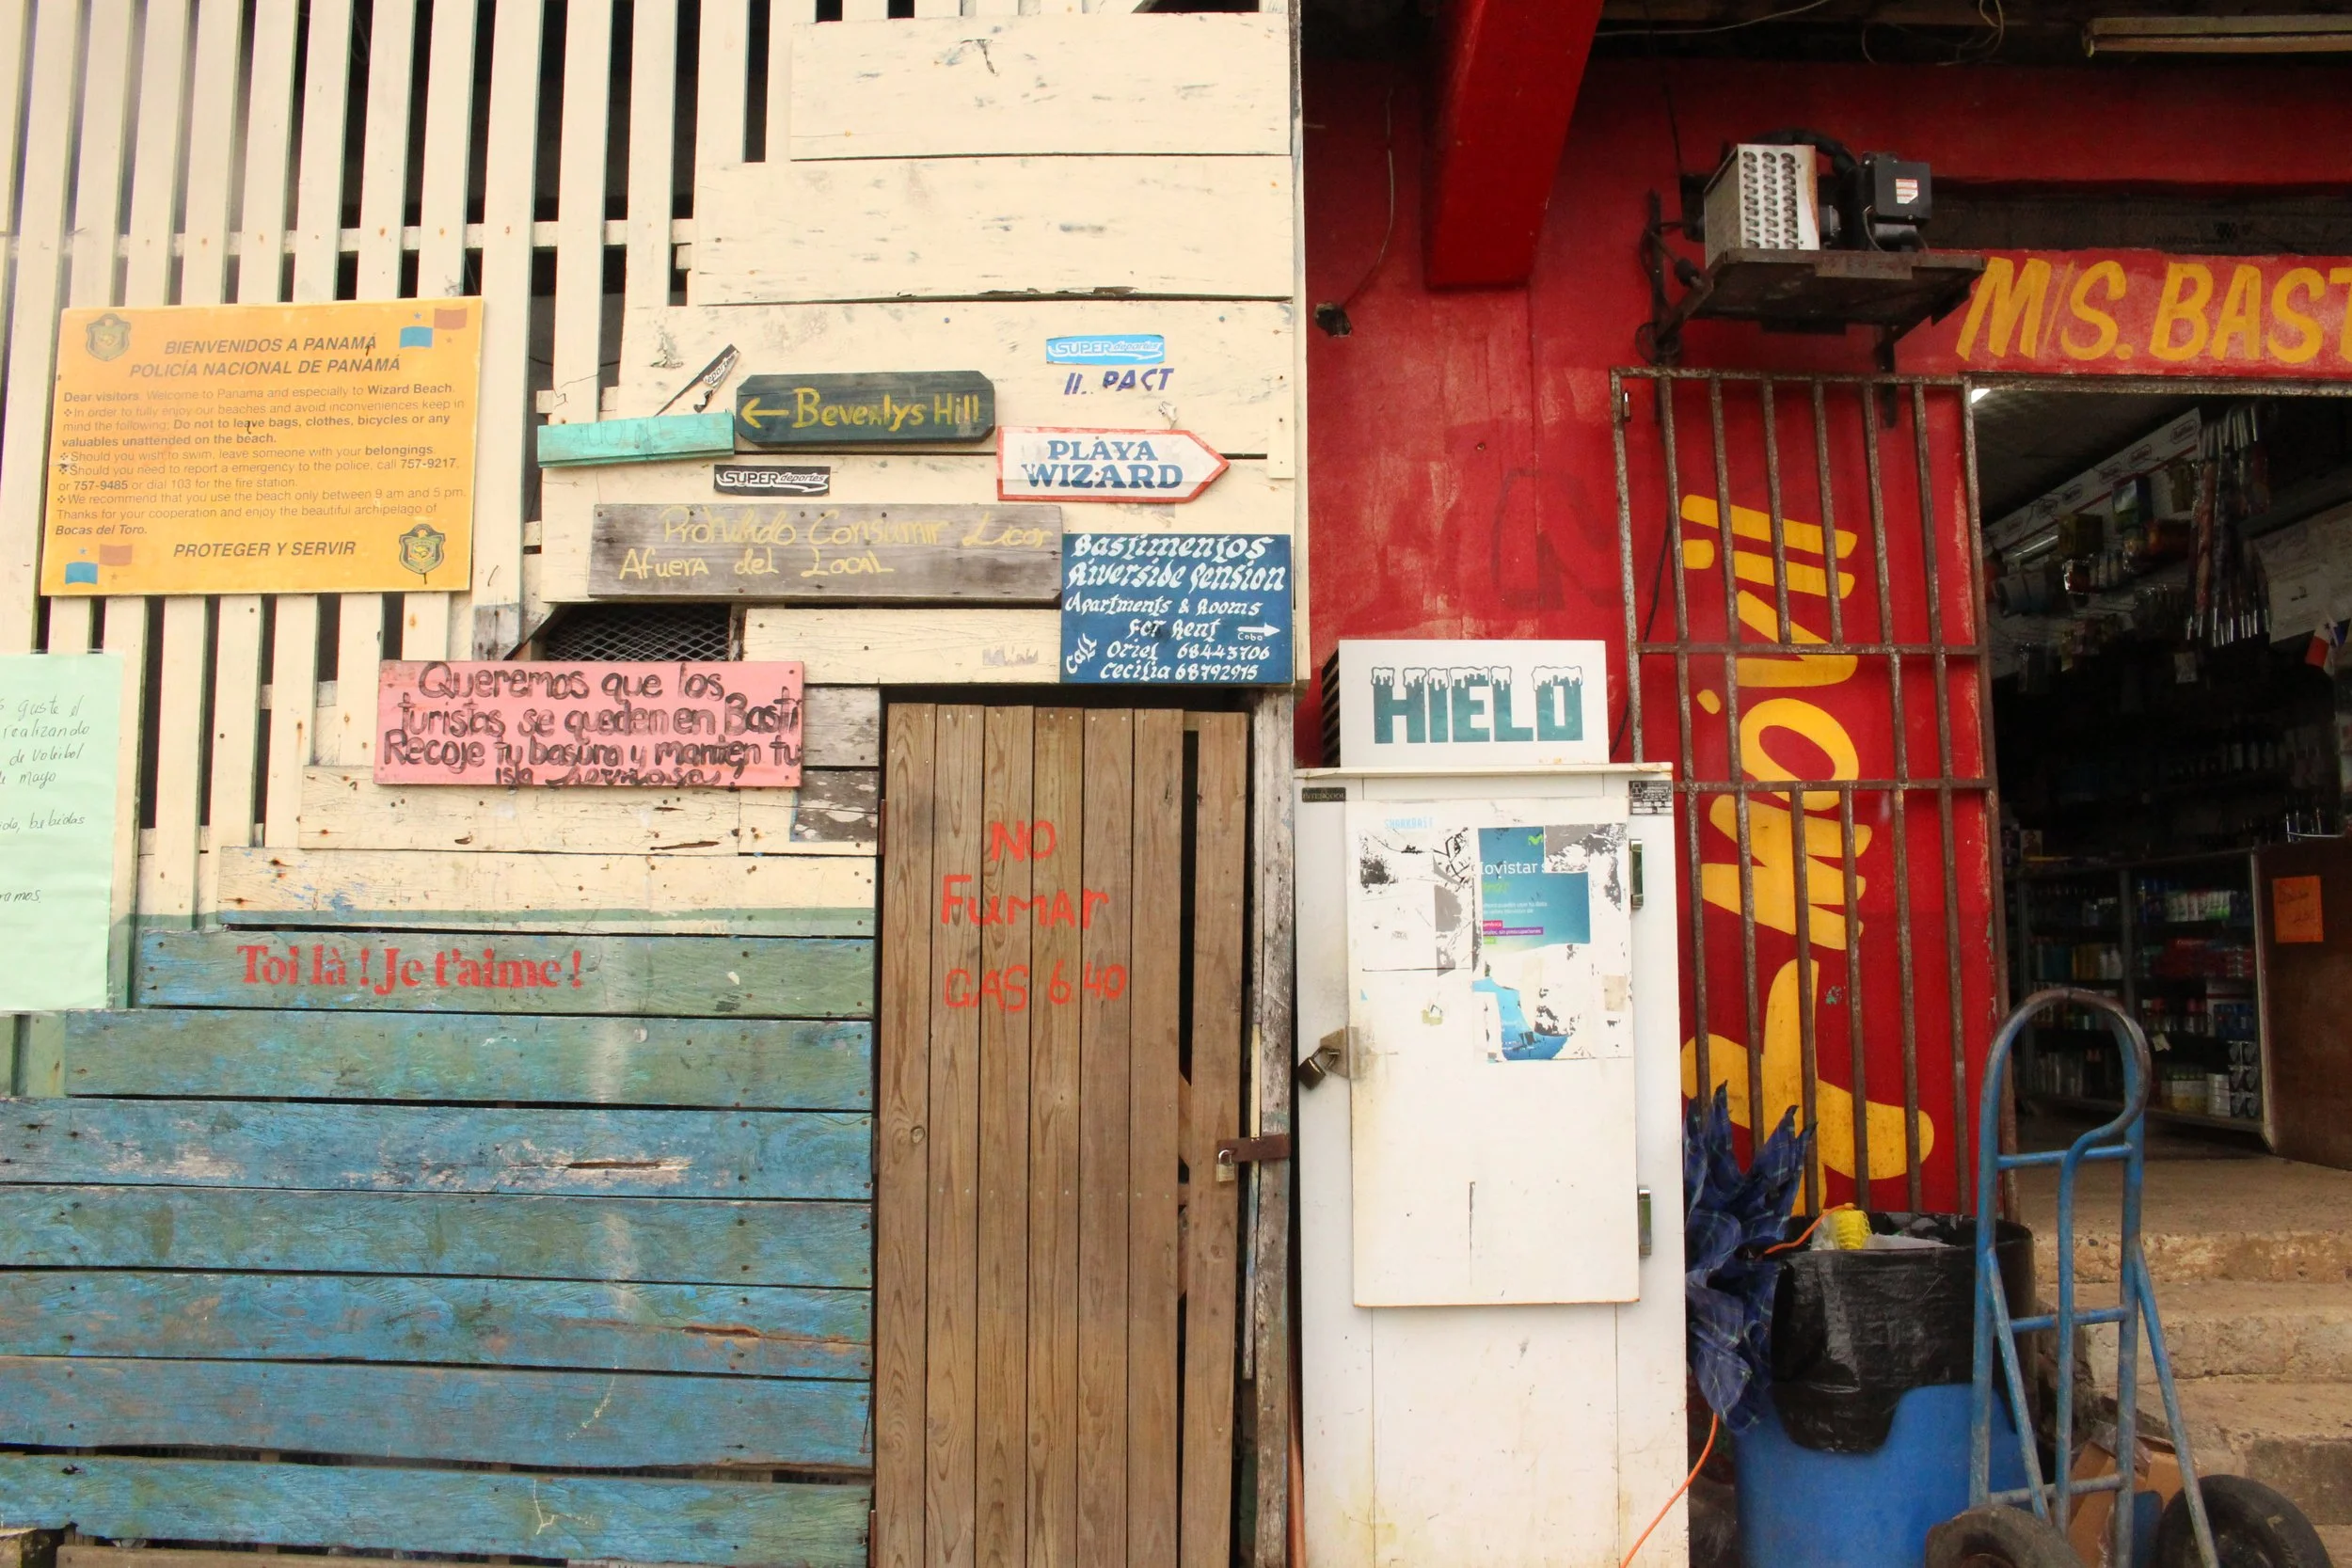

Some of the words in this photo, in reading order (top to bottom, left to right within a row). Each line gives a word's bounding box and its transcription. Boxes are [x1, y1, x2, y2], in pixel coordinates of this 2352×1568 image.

[165, 339, 282, 355] BIENVENIDOS
[286, 339, 298, 352] A
[303, 332, 376, 352] PANAMÁ
[129, 359, 198, 377] POLICÍA
[203, 361, 292, 376] NACIONAL
[297, 359, 323, 373] DE
[326, 354, 401, 372] PANAMÁ
[64, 392, 92, 403] Dear
[147, 390, 199, 401] Welcome
[203, 389, 214, 400] to
[217, 388, 263, 399] Panama
[267, 388, 290, 398] and
[293, 386, 348, 399] especially
[353, 386, 364, 396] to
[367, 384, 410, 395] Wizard
[934, 392, 980, 426] Hill
[63, 420, 90, 432] mind
[95, 420, 113, 431] the
[173, 419, 190, 430] Do
[194, 419, 215, 429] not
[217, 419, 230, 429] to
[233, 417, 264, 429] leave
[269, 417, 302, 430] bags,
[306, 415, 354, 427] clothes,
[358, 414, 408, 428] bicycles
[411, 414, 424, 424] or
[428, 414, 451, 426] any
[62, 436, 119, 448] valuables
[122, 435, 191, 447] unattended
[195, 436, 210, 445] on
[214, 434, 232, 444] the
[235, 433, 277, 444] beach.
[1047, 439, 1159, 462] PLAYA
[71, 451, 110, 463] Should
[115, 452, 135, 464] you
[139, 450, 164, 461] wish
[167, 450, 179, 460] to
[183, 450, 215, 461] swim,
[219, 449, 248, 459] leave
[253, 448, 306, 459] someone
[310, 446, 333, 457] with
[336, 447, 361, 459] your
[69, 465, 110, 476] Should
[113, 466, 134, 478] you
[137, 464, 166, 475] need
[168, 464, 180, 474] to
[183, 463, 217, 476] report
[221, 465, 229, 473] a
[231, 461, 294, 475] emergency
[298, 461, 310, 471] to
[313, 460, 331, 471] the
[335, 459, 373, 473] police,
[376, 458, 396, 470] call
[1021, 463, 1184, 489] WIZARD
[58, 482, 70, 492] or
[74, 481, 129, 491] 757-9485
[132, 481, 144, 491] or
[147, 479, 167, 490] dial
[171, 479, 191, 490] 103
[195, 478, 210, 489] for
[214, 478, 232, 488] the
[235, 477, 253, 488] fire
[256, 477, 297, 488] station.
[56, 508, 98, 520] Thanks
[103, 508, 117, 519] for
[119, 509, 145, 521] your
[149, 506, 216, 520] cooperation
[220, 506, 242, 517] and
[245, 505, 277, 518] enjoy
[279, 505, 298, 515] the
[301, 503, 351, 516] beautiful
[354, 502, 422, 516] archipelago
[425, 502, 437, 513] of
[56, 525, 92, 535] Bocas
[96, 524, 115, 535] del
[119, 524, 148, 535] Toro.
[173, 543, 270, 558] PROTEGER
[277, 542, 290, 556] Y
[291, 541, 357, 556] SERVIR
[1071, 533, 1275, 563] Bastimentos
[1066, 558, 1186, 590] Riverside
[1064, 591, 1173, 617] Apartments
[1178, 597, 1189, 614] &
[419, 661, 590, 700] Queremos
[600, 673, 662, 705] que
[679, 662, 724, 702] los
[1372, 665, 1583, 743] HIELO
[398, 692, 506, 737] turistas
[517, 707, 556, 736] se
[564, 700, 669, 746] queden
[673, 707, 717, 735] en
[384, 728, 485, 774] Recoje
[530, 735, 623, 767] basura
[990, 819, 1057, 863] NO
[237, 943, 299, 986] Toi
[373, 947, 424, 996] Je
[434, 947, 562, 989] t'aime
[945, 964, 1029, 1012] GAS
